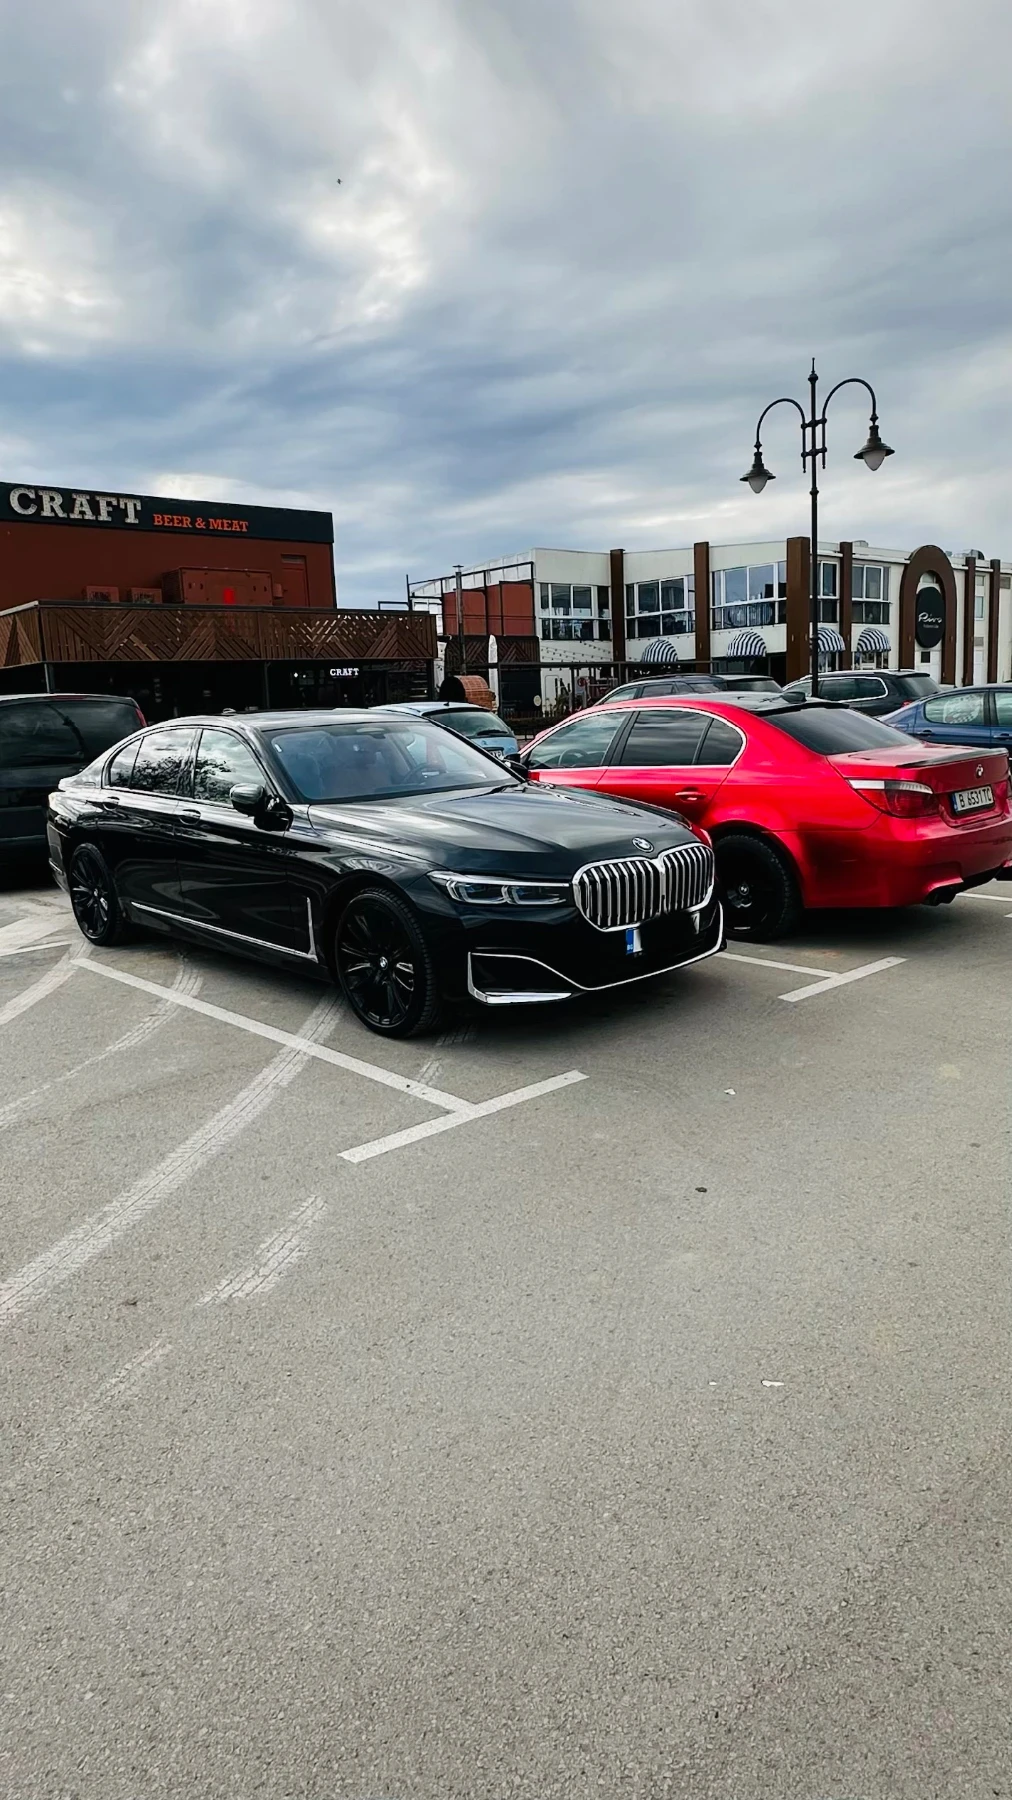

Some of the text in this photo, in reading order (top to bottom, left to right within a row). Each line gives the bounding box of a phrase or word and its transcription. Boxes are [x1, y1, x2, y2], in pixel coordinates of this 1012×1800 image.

[9, 487, 142, 524] CRAFT
[153, 513, 248, 532] BEER & MEAT
[329, 667, 359, 676] CRAFT
[959, 794, 965, 808] B
